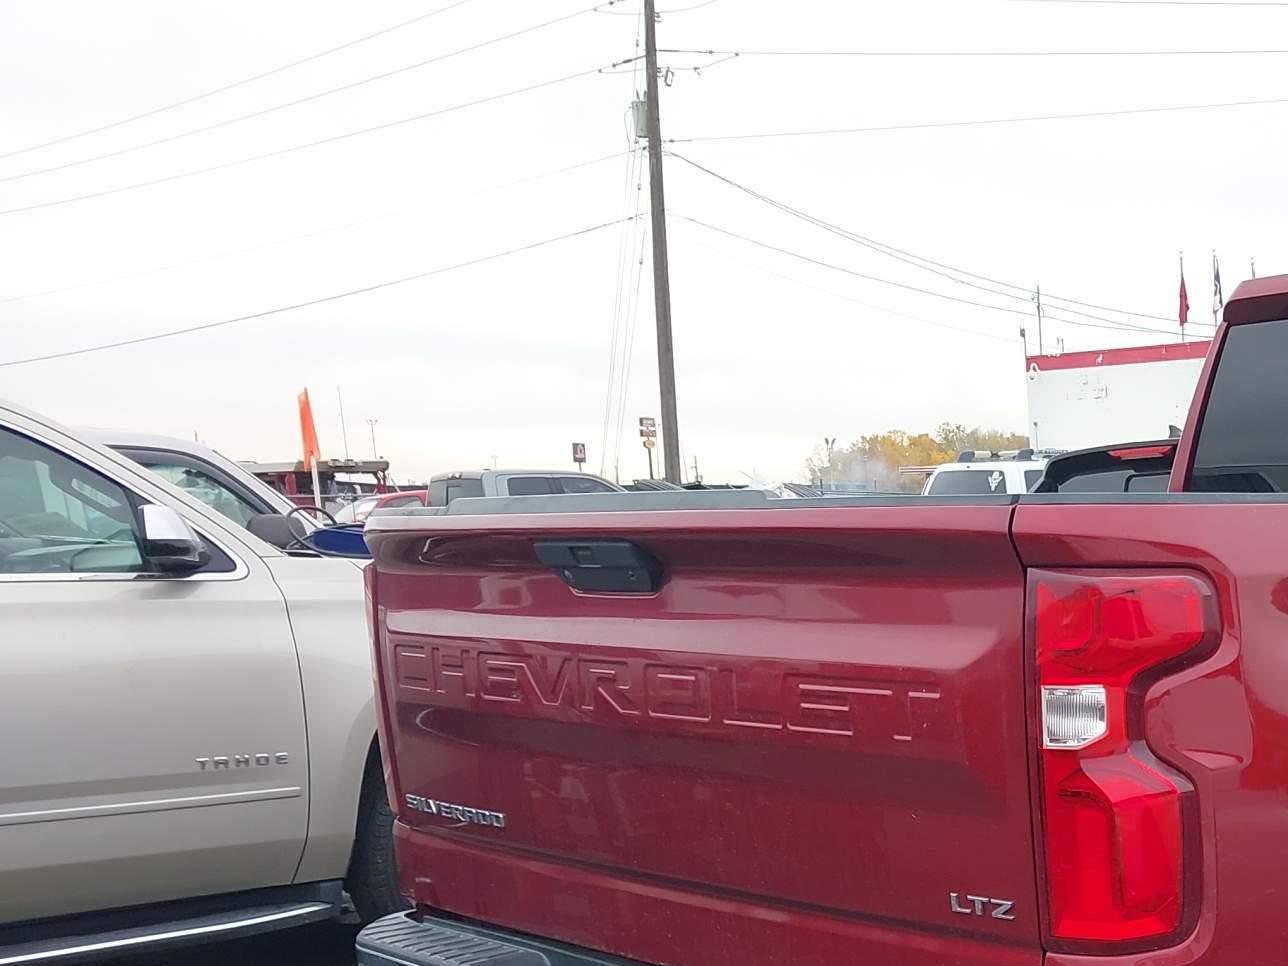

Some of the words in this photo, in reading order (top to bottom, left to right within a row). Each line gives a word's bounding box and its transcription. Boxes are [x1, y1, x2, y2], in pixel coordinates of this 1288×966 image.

[395, 644, 941, 741] CHEVROLET
[194, 752, 289, 770] TAHOE
[405, 793, 505, 828] SILVERADO
[949, 891, 1017, 920] LTZ
